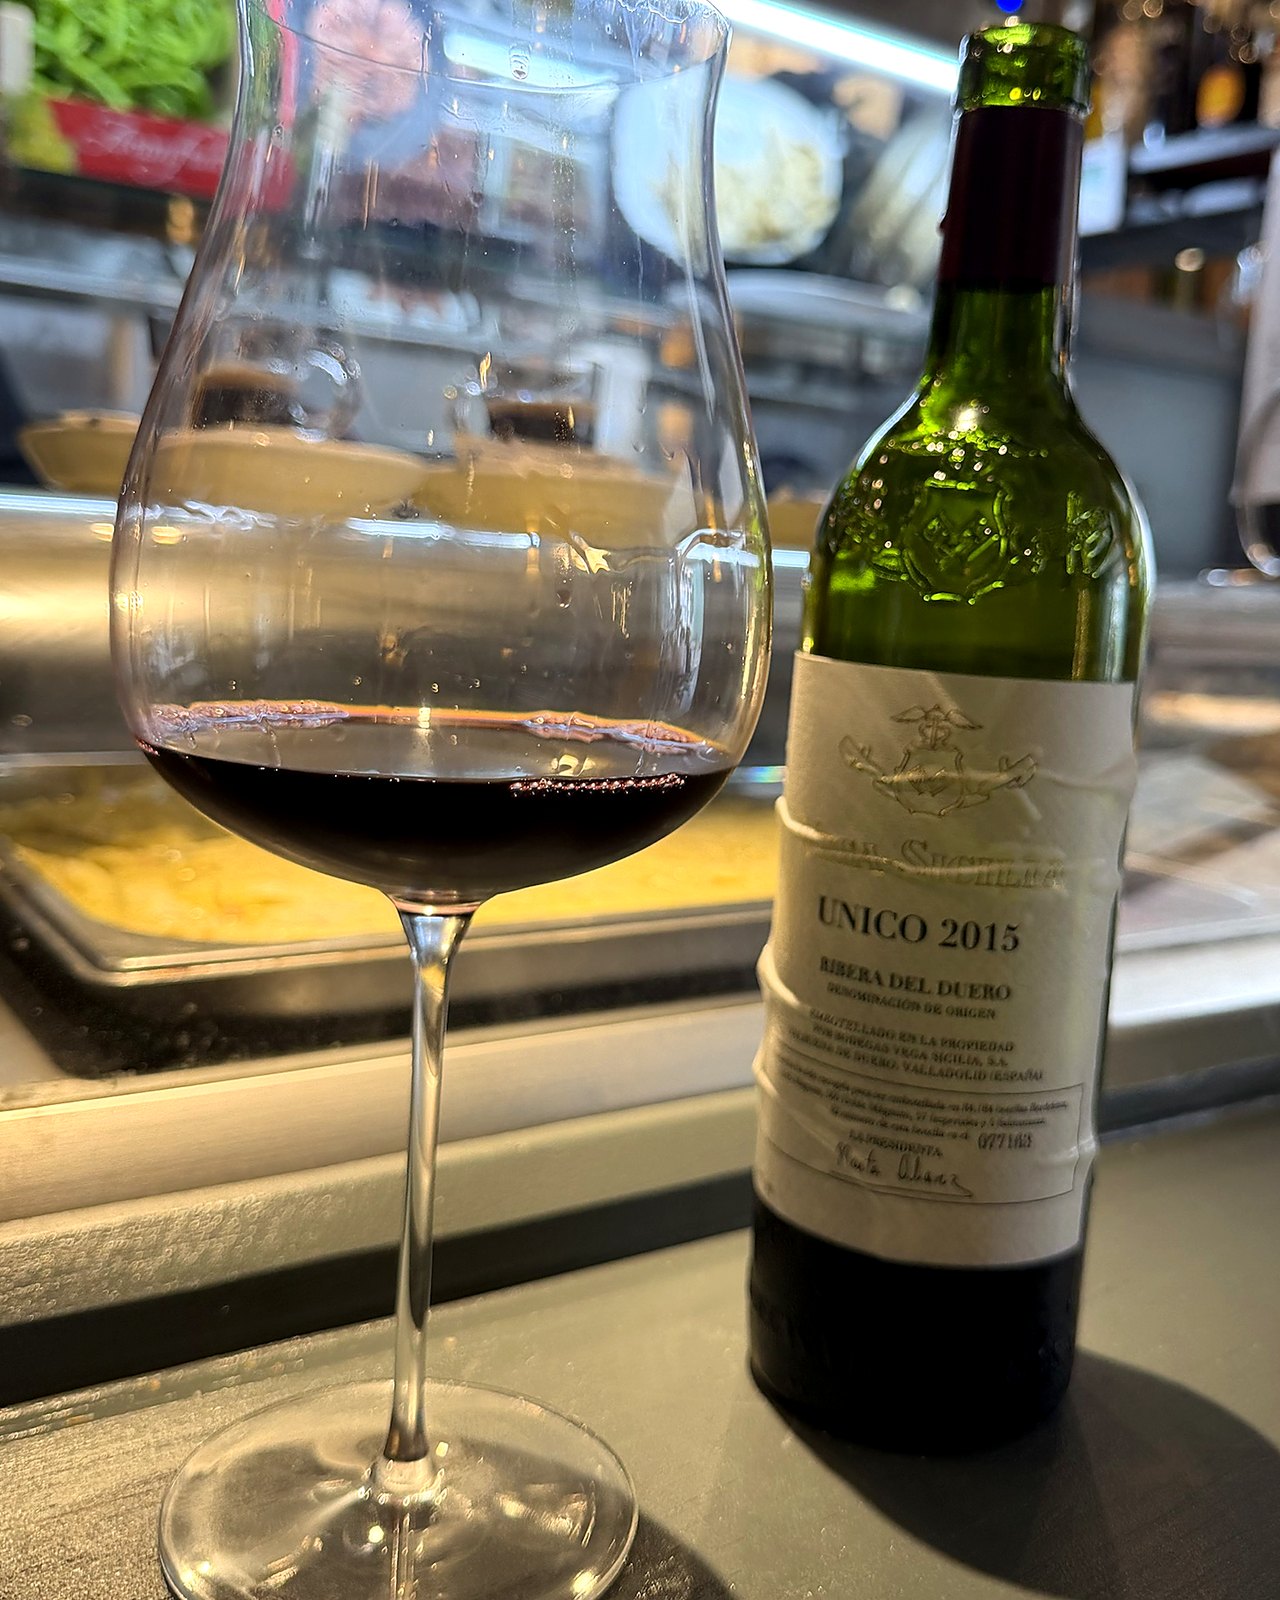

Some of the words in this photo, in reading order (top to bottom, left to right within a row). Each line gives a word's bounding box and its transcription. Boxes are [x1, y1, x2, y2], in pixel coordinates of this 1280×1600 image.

[817, 895, 928, 944] UNICO
[938, 918, 1020, 952] 2015
[819, 956, 885, 987] RIBERA
[888, 971, 931, 995] DEL
[937, 979, 1012, 1001] DUERO
[923, 1001, 942, 1016] DE
[945, 1005, 996, 1020] ORIGEN
[919, 1034, 937, 1048] LA
[940, 1038, 1015, 1052] PROPIEDAD
